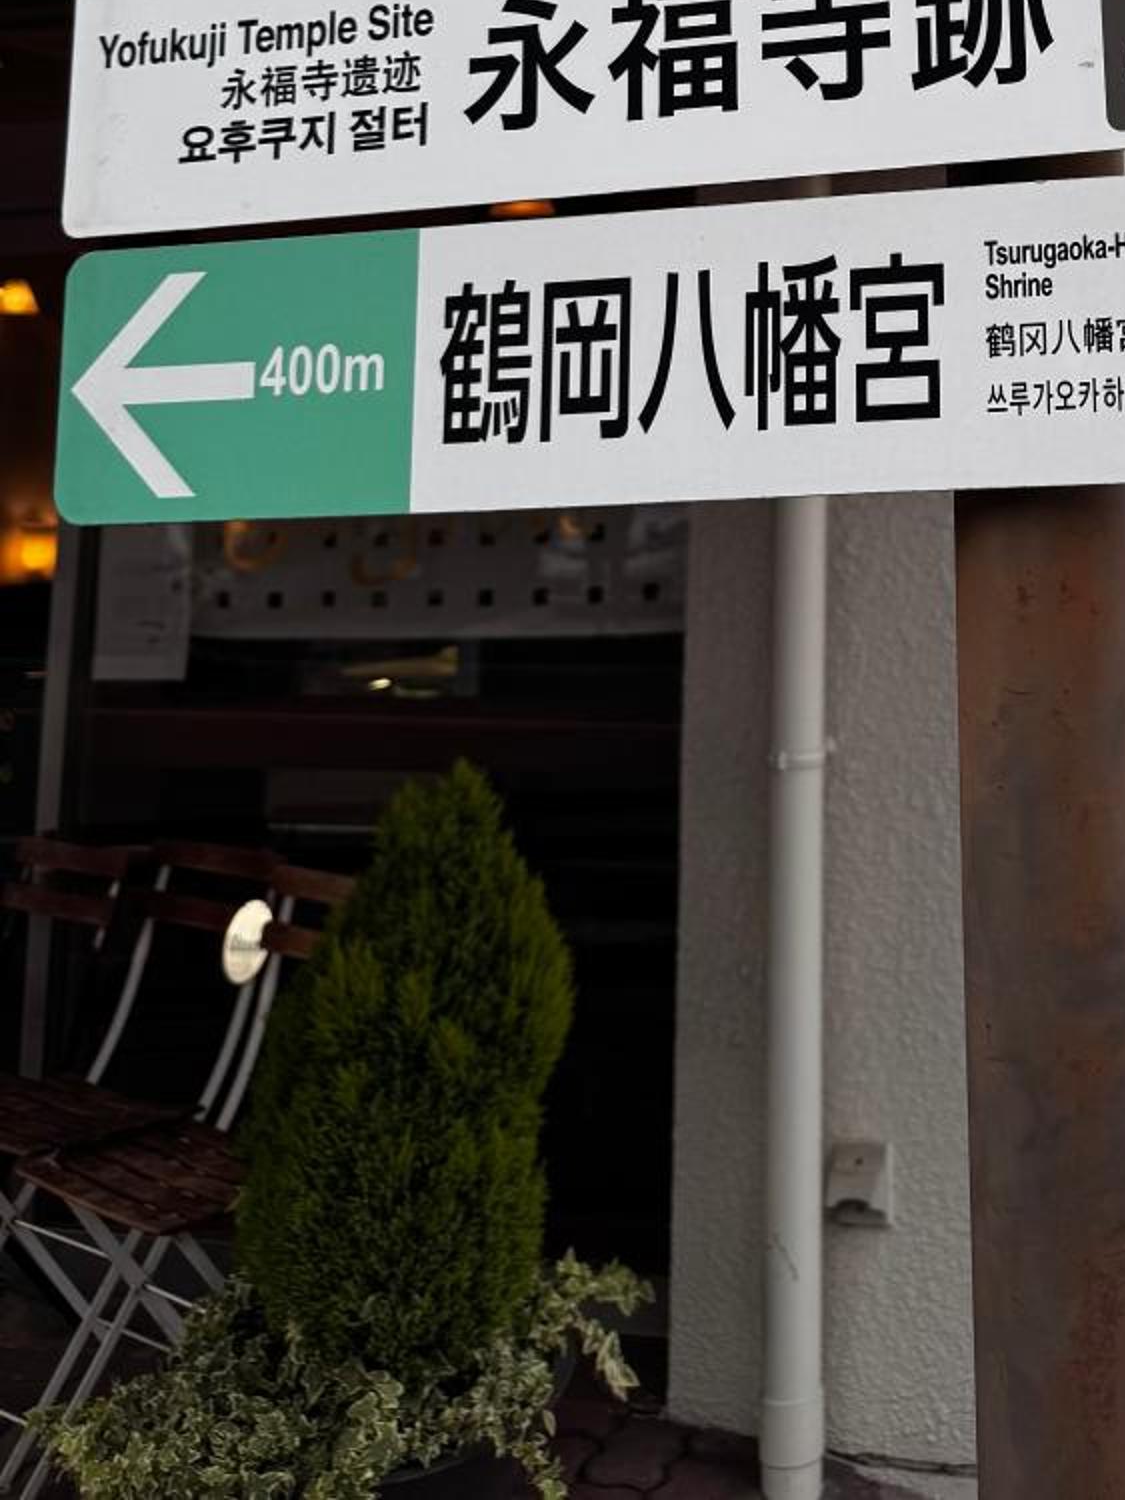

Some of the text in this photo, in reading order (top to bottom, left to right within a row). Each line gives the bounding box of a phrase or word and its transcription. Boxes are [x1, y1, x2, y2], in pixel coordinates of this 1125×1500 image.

[99, 3, 434, 68] Yofukuji Temple Site
[221, 50, 421, 110] 永福寺遗迹
[178, 102, 429, 164] 요후쿠지 절터
[985, 272, 1053, 299] Shrine
[259, 343, 385, 396] 400m
[439, 253, 944, 444] 鶴岡八幡宮
